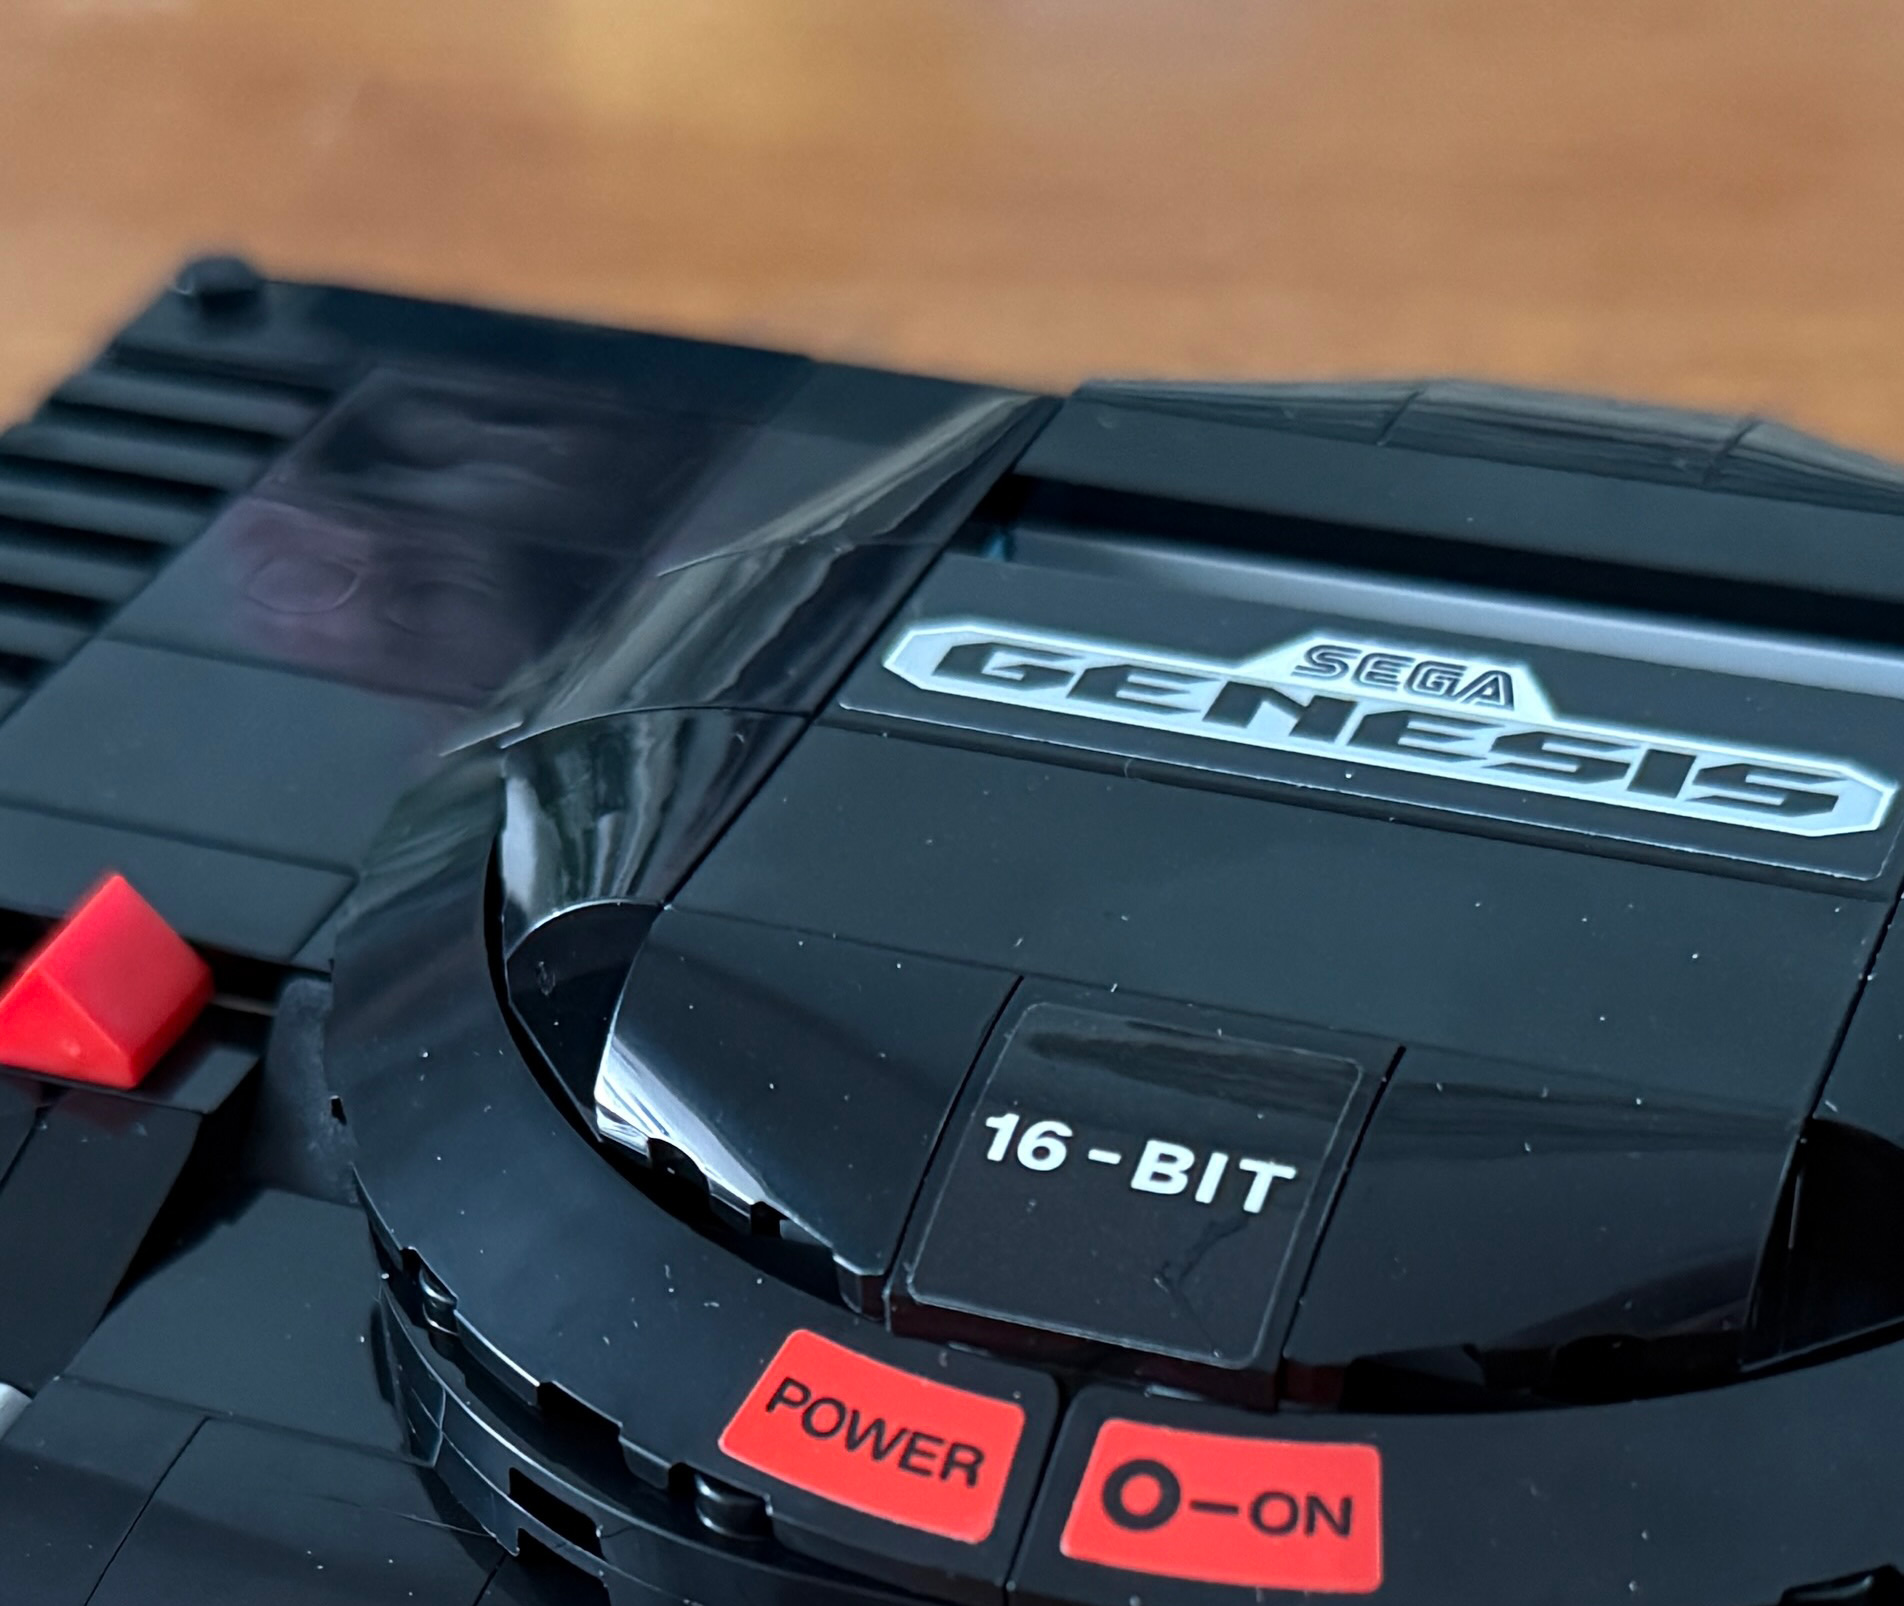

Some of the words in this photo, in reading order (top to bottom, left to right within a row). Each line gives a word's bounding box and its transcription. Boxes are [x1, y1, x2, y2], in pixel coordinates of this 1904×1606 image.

[1291, 642, 1516, 708] SEGA
[933, 640, 1840, 817] GENESIS
[985, 1114, 1296, 1213] 16-BIT
[765, 1378, 985, 1487] POWER
